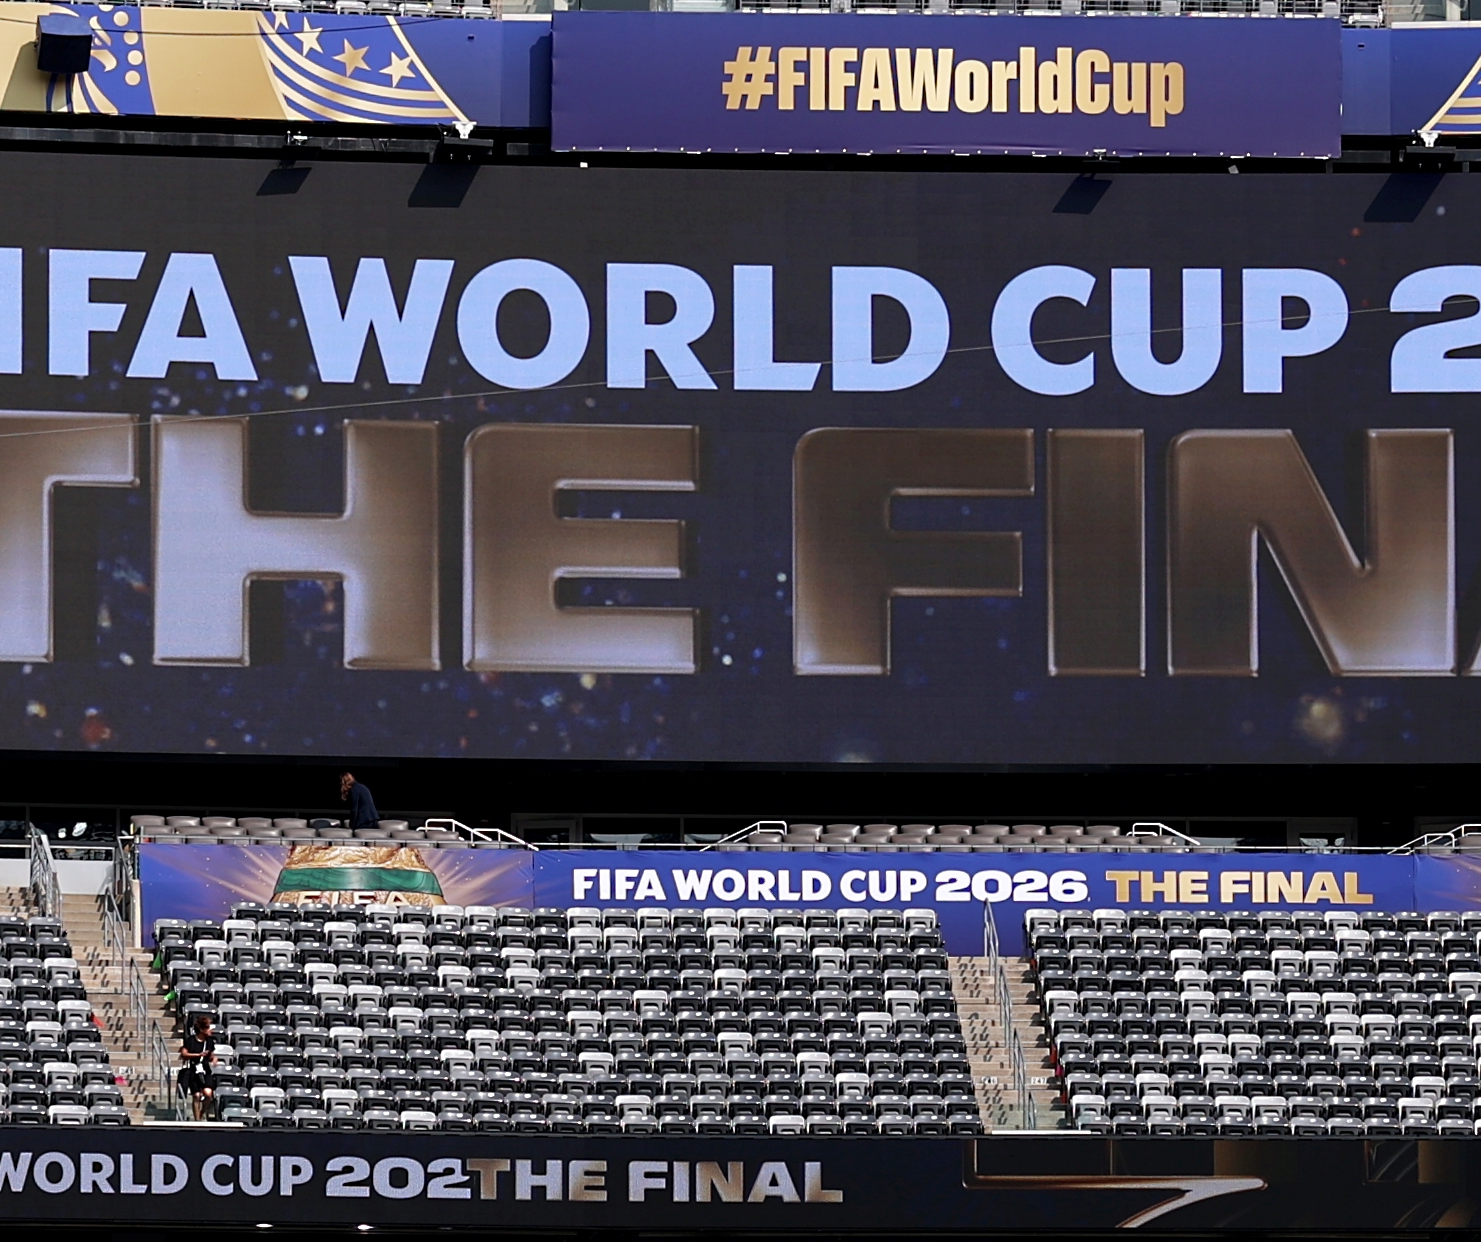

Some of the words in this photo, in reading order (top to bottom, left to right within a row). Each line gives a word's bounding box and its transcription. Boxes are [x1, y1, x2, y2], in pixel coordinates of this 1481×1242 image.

[722, 46, 1184, 127] #FIFAWorldCup
[288, 256, 951, 393] WORLD
[991, 264, 1350, 396] CUP
[573, 868, 666, 900] FIFA
[673, 869, 832, 901] WORLD
[840, 870, 927, 902] CUP
[936, 870, 1088, 902] 2026
[1106, 871, 1209, 903] THE
[1220, 871, 1374, 904] FINAL
[201, 1154, 314, 1197] CUP
[466, 1158, 607, 1201] THE
[628, 1160, 844, 1203] FINAL
